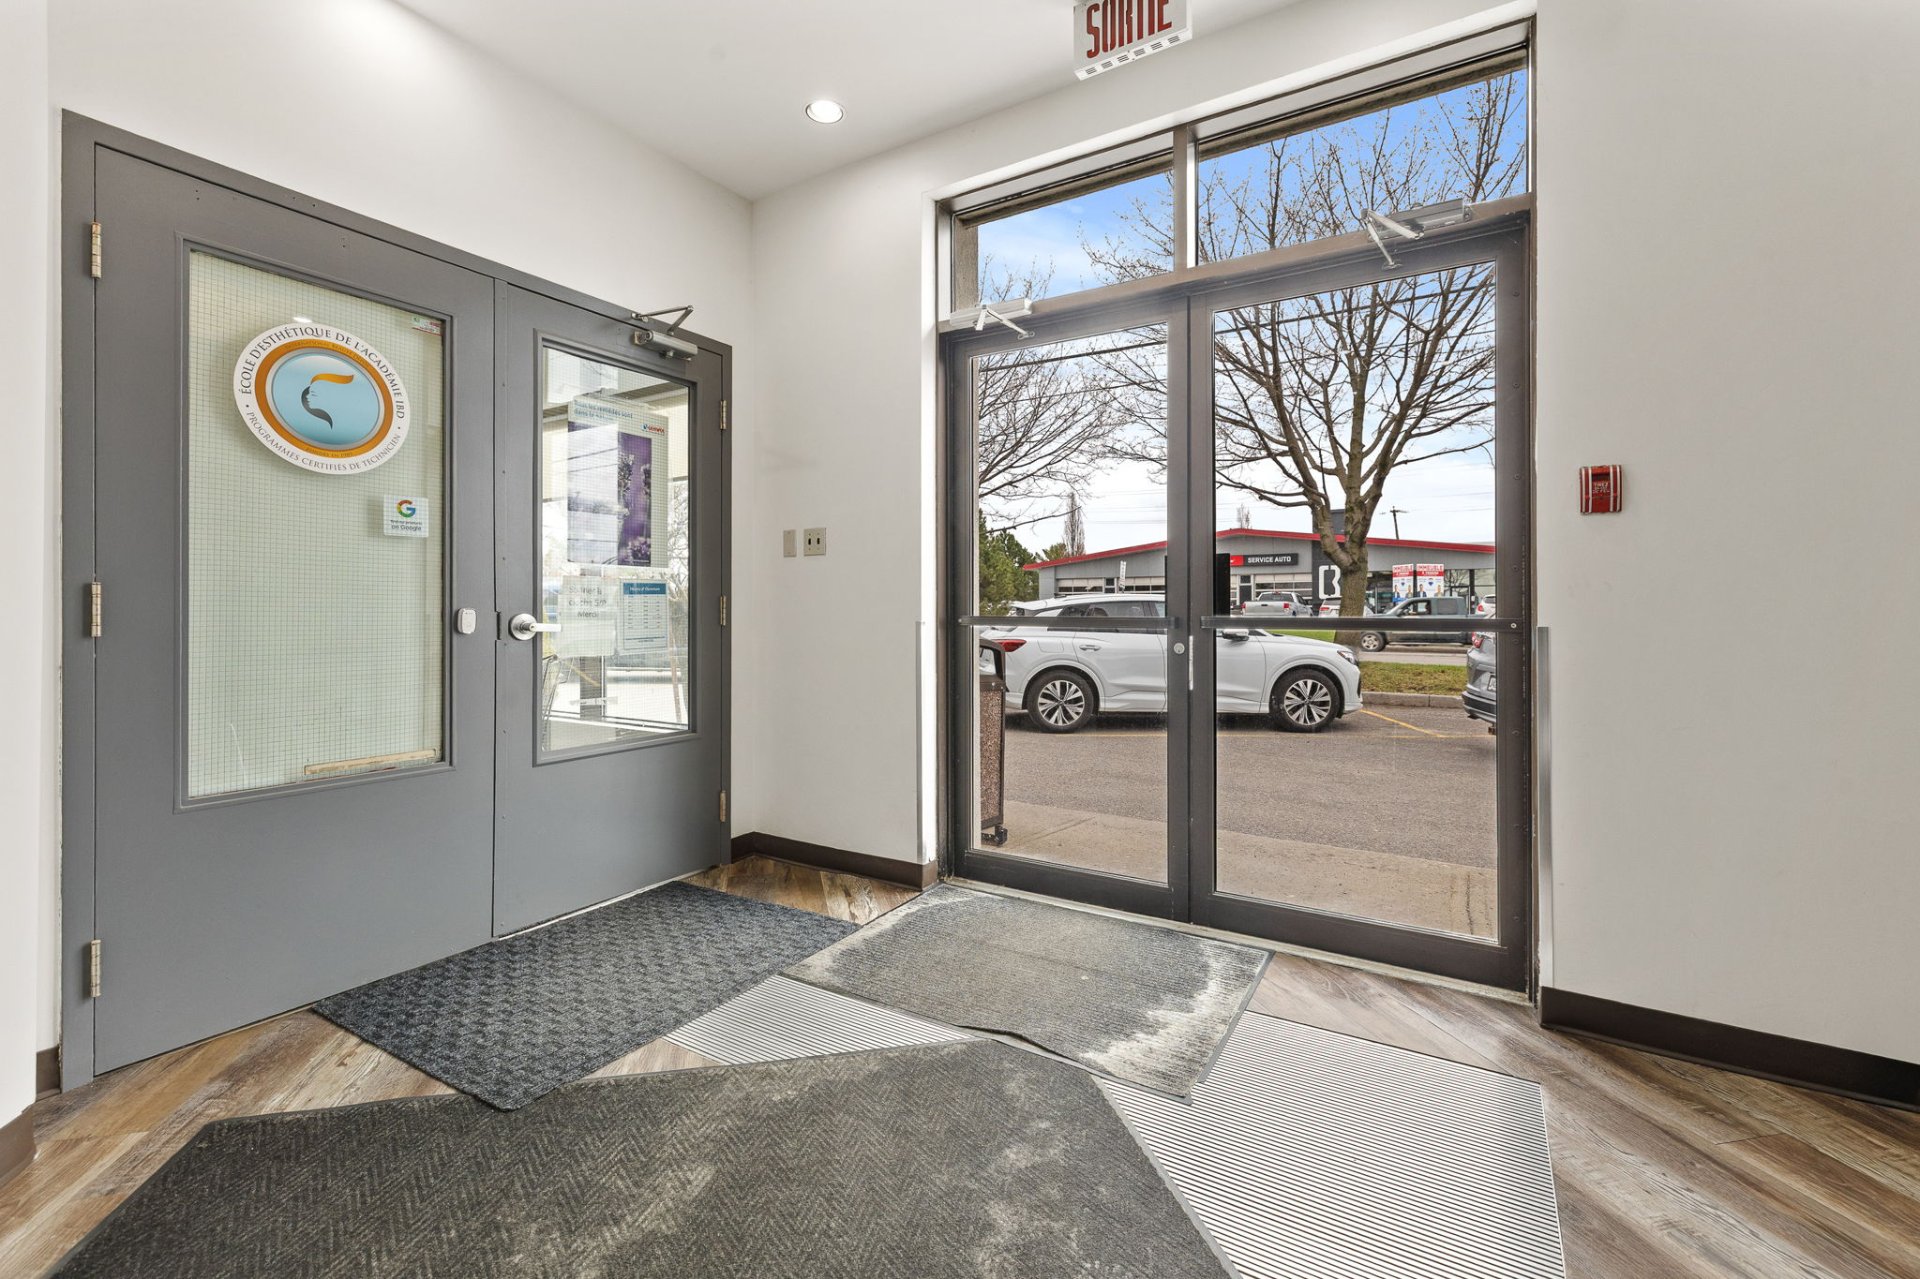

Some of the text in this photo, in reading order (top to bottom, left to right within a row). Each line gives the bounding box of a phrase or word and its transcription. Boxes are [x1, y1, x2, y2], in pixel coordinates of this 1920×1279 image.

[1086, 0, 1172, 58] SORTIE
[239, 359, 256, 394] ÉCOLE
[249, 327, 331, 360] D'ESTHÉTIQUE
[335, 332, 352, 346] DE
[354, 341, 403, 397] L'ACADÉMIE
[395, 400, 405, 419] IBD
[247, 412, 300, 461] PROGRAMMES
[349, 463, 361, 471] DE
[361, 434, 401, 468] TECHNICIEN
[1274, 555, 1292, 563] AUTO
